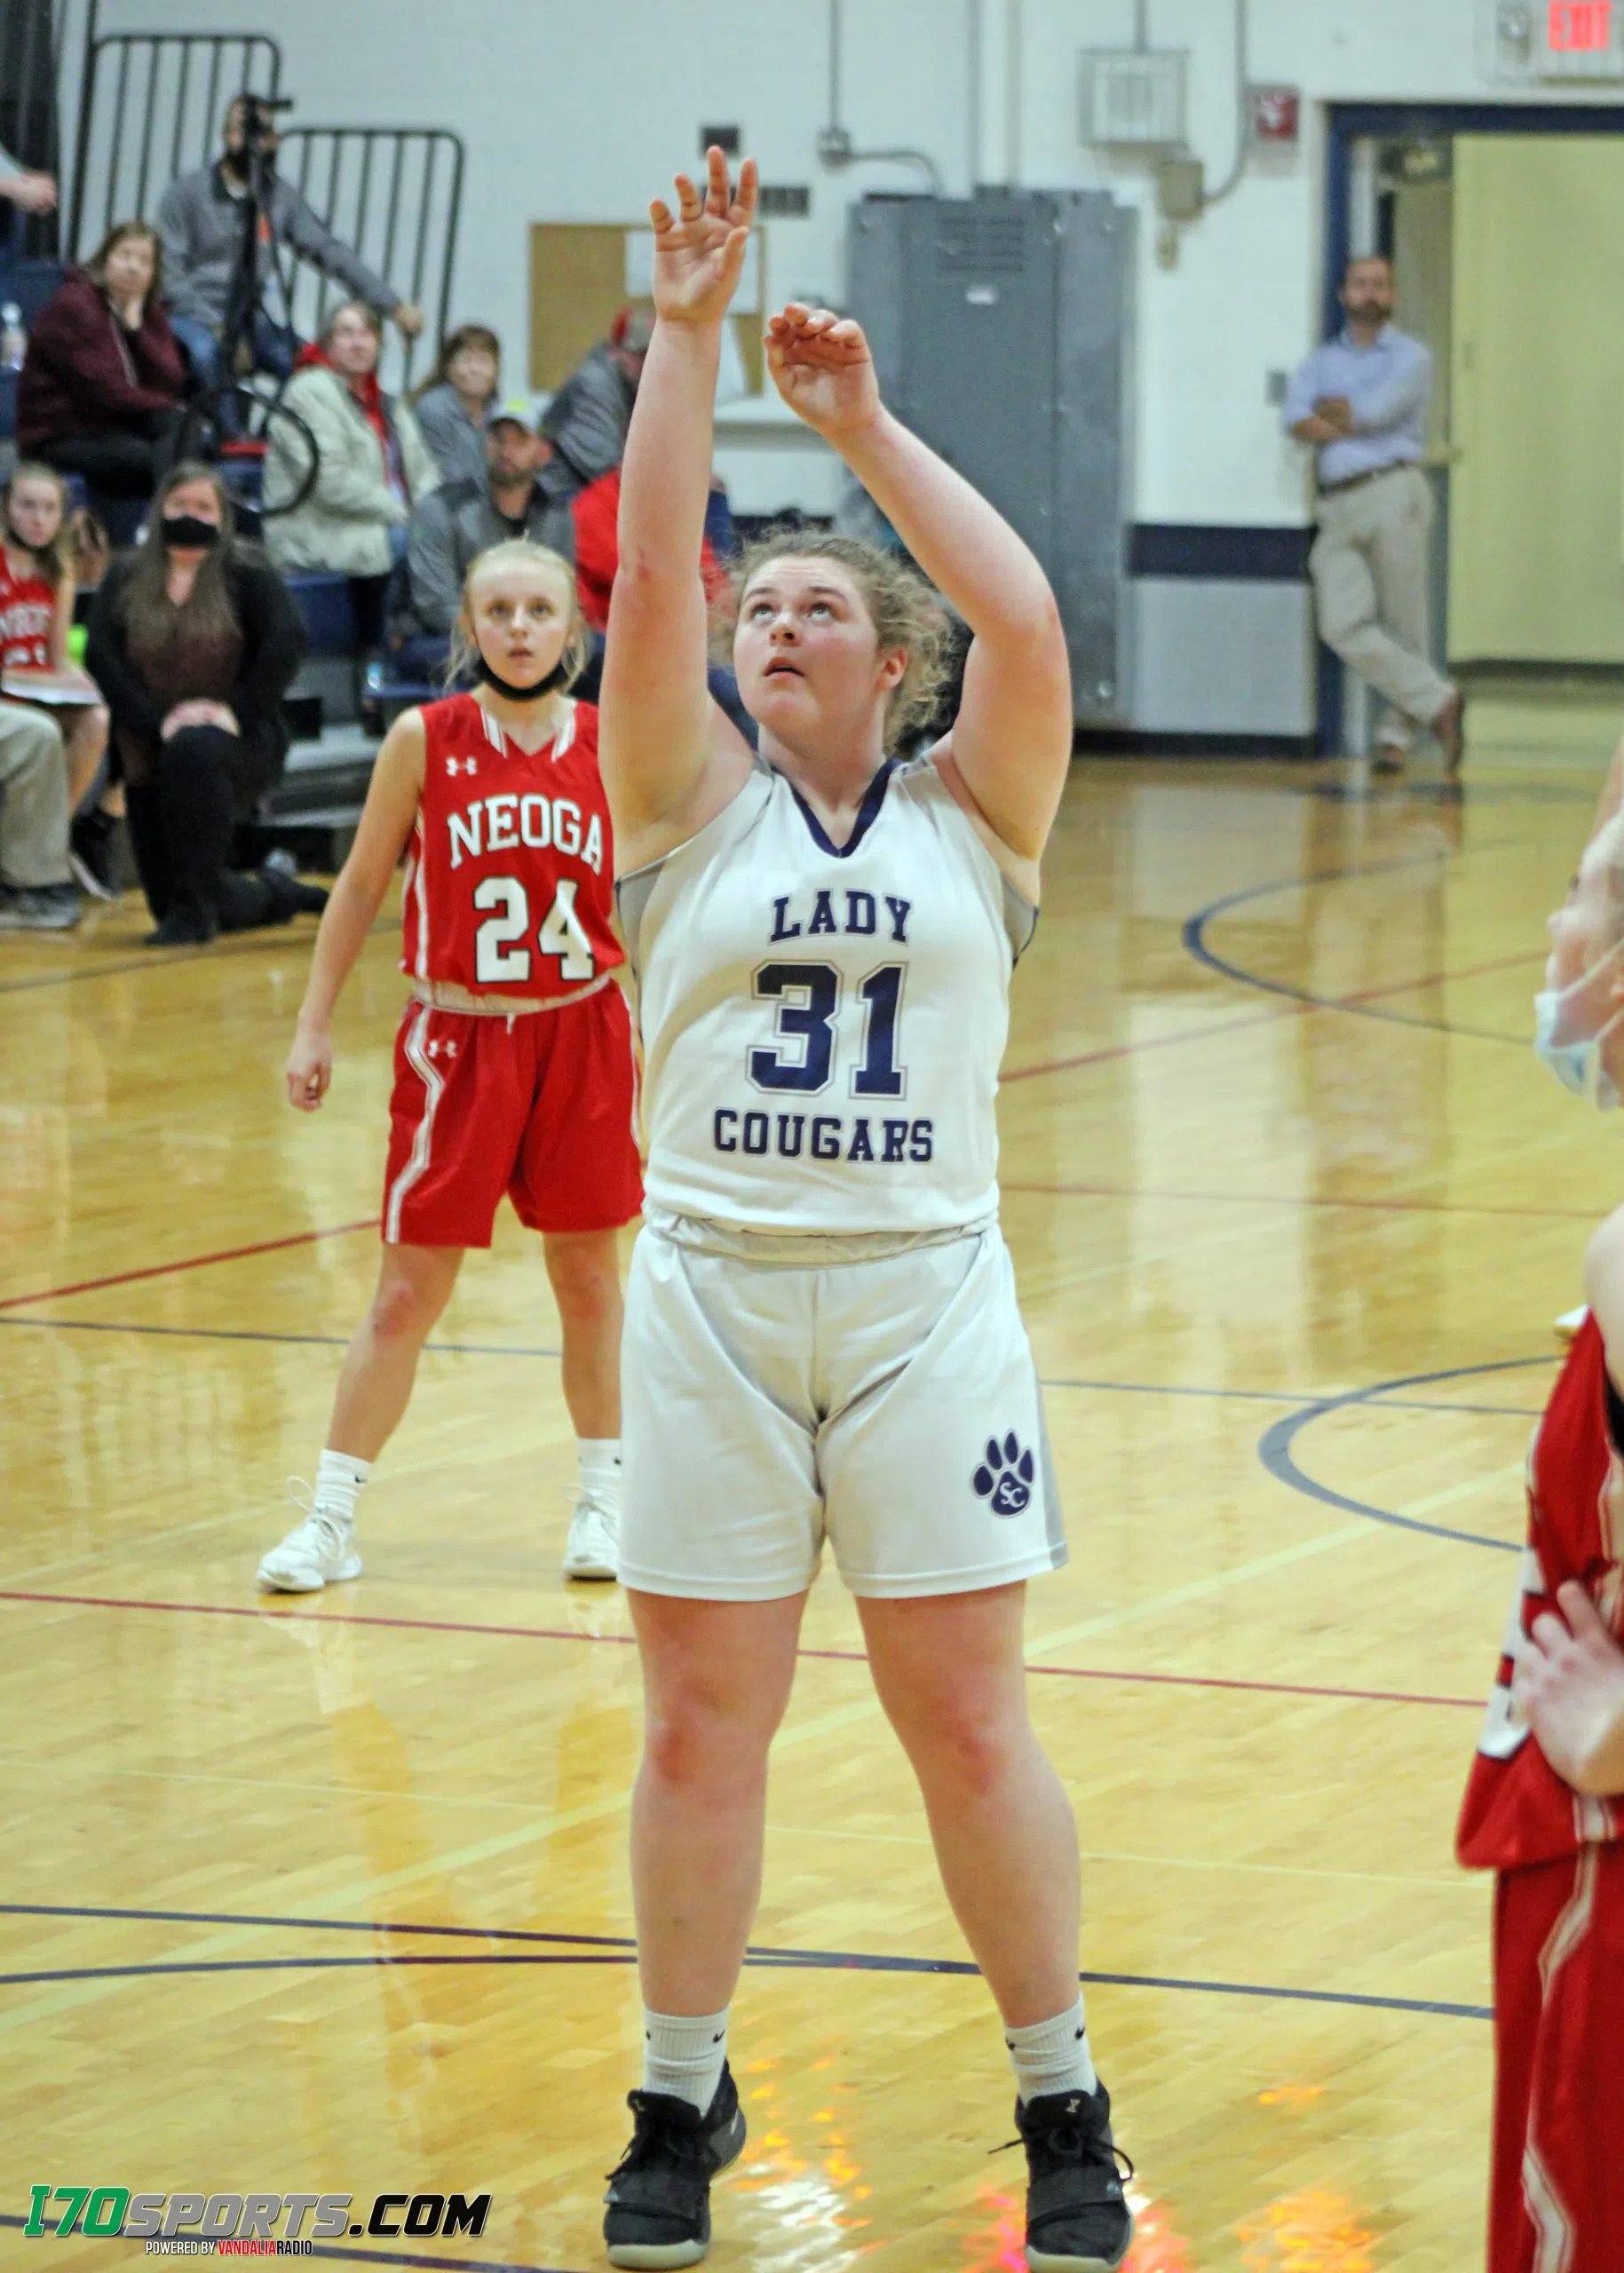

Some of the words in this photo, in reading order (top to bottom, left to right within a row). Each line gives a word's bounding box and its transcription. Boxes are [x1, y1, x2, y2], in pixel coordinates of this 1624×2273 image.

[1548, 0, 1612, 51] EXIT
[447, 795, 603, 875] NEOGA
[473, 875, 595, 983] 24
[768, 889, 912, 945] LADY
[746, 958, 909, 1100] 31
[713, 1107, 934, 1164] COUGARS
[1000, 1482, 1026, 1508] SC
